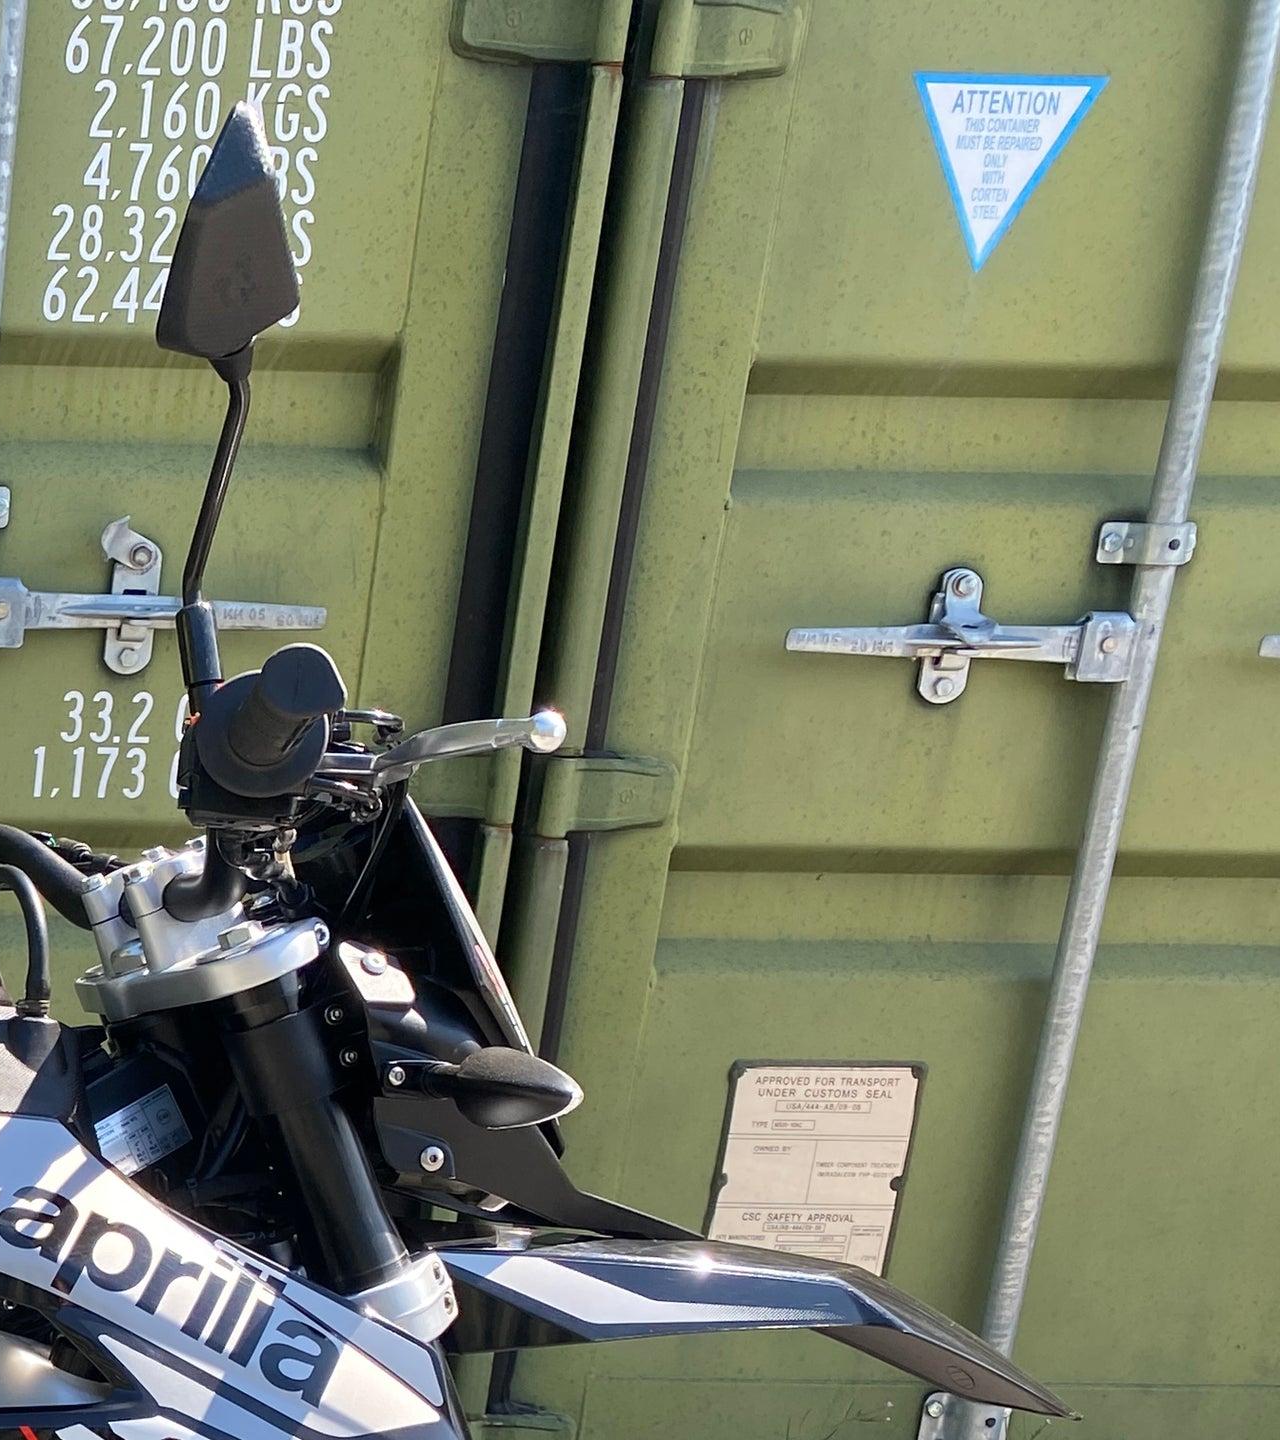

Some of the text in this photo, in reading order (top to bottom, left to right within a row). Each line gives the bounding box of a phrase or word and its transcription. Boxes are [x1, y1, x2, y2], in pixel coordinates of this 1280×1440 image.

[64, 14, 334, 80] 67,200 LBS
[89, 78, 222, 141] 2,160
[951, 89, 1062, 116] ATTENTION
[965, 117, 1041, 133] THIS CONTAINER
[955, 135, 1044, 152] MUST BE REPAIRED
[983, 153, 1008, 169] ONLY
[981, 170, 1005, 185] WITH
[970, 187, 1010, 203] CORTEN
[971, 204, 1001, 220] STEEL
[46, 203, 177, 264] 28,32
[42, 265, 168, 324] 62,44
[59, 690, 155, 744] 33.2
[33, 745, 148, 800] 1,173
[754, 1076, 901, 1087] APPROVED FOR TRANSPORT
[757, 1088, 894, 1100] UNDER CUSTOMS SEAL
[751, 1120, 769, 1129] TYPE
[741, 1212, 856, 1223] CSC SAFETY APPROVAL
